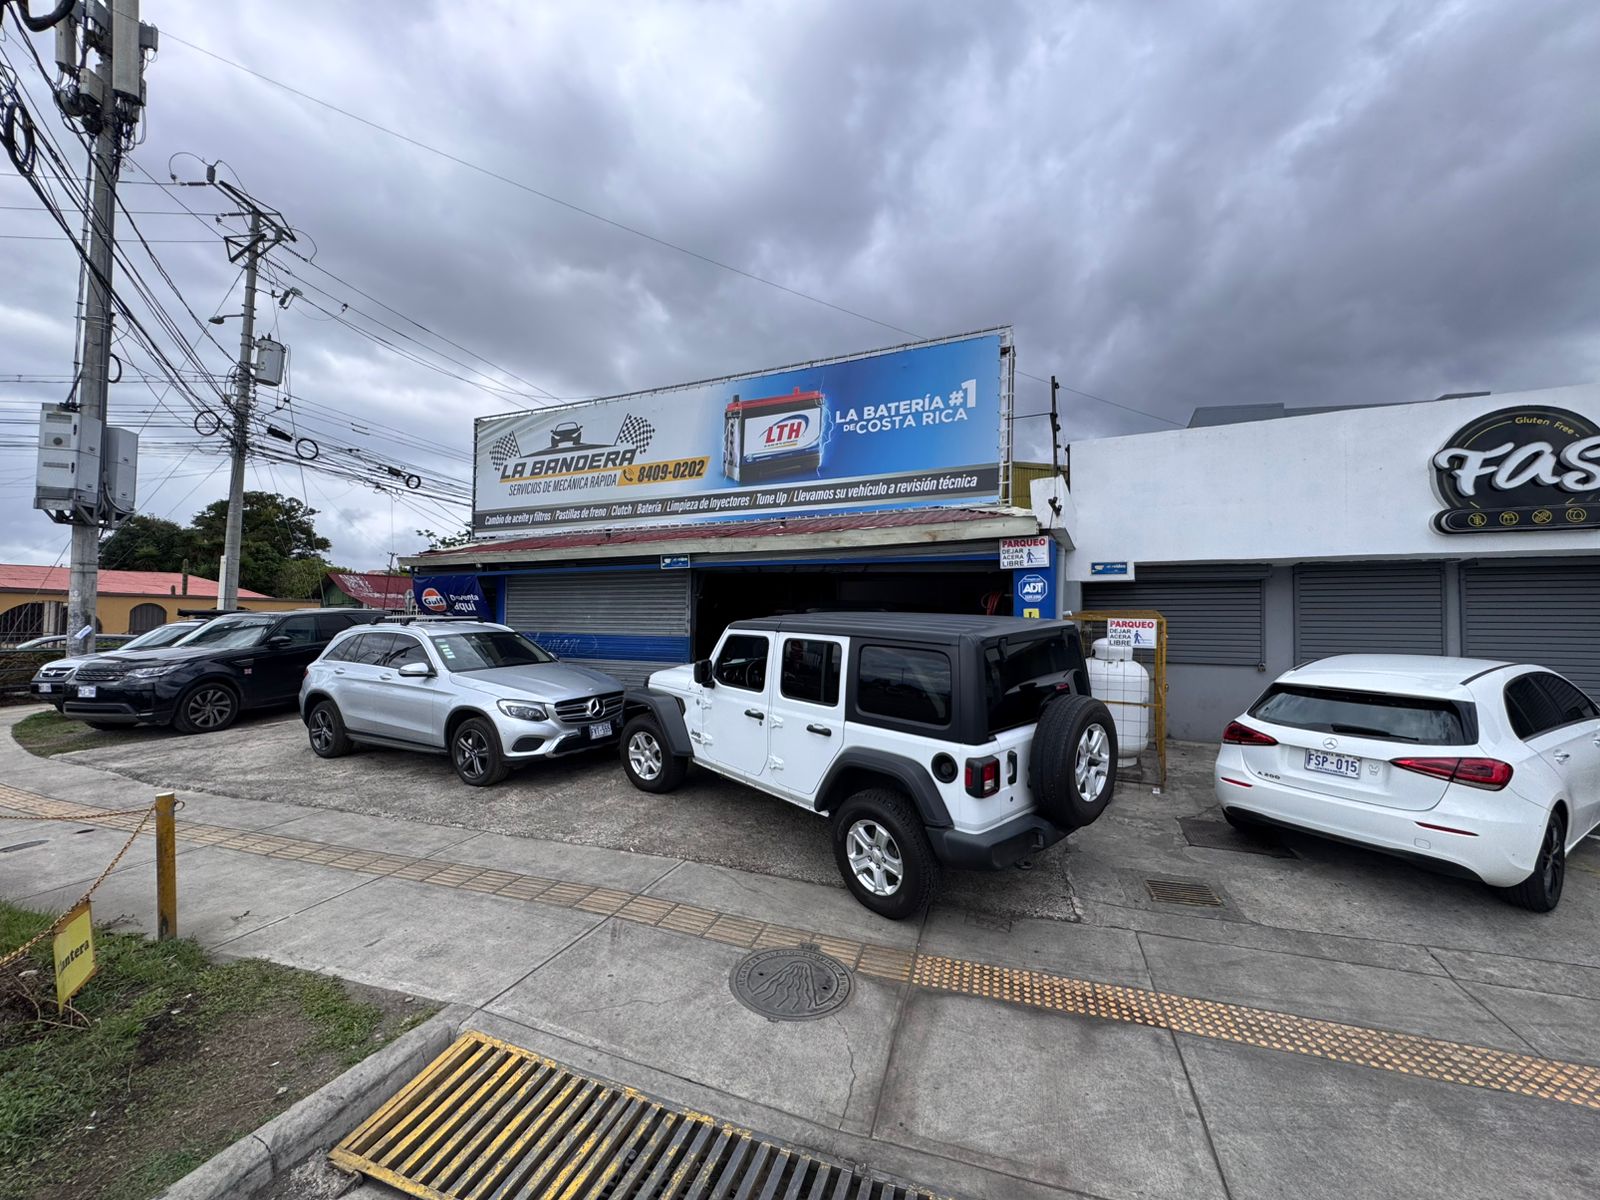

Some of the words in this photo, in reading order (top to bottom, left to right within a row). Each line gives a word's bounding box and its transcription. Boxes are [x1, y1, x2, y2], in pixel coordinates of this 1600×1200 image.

[835, 408, 858, 423] LA
[863, 393, 945, 420] BATERÍA
[948, 378, 977, 409] #1
[843, 423, 855, 432] DE
[855, 415, 916, 434] COSTA
[922, 407, 968, 426] RICA
[1515, 416, 1550, 426] Gluten
[1553, 421, 1575, 435] Free
[764, 421, 802, 444] LTH
[500, 462, 527, 480] LA
[530, 449, 638, 477] BANDERA
[637, 459, 705, 482] 8409-0202
[508, 481, 542, 497] SERVICIOS
[542, 481, 552, 493] DE
[552, 475, 589, 492] MECÁNICA
[589, 472, 617, 489] RÁPIDA
[485, 514, 504, 525] Cambio
[505, 513, 511, 524] de
[512, 512, 529, 524] aceite
[528, 515, 534, 525] y
[534, 511, 551, 522] filtros
[555, 508, 580, 520] Pastillas
[581, 507, 589, 518] de
[589, 506, 607, 518] freno
[611, 504, 632, 516] Clutch
[637, 502, 661, 514] Batería
[666, 499, 698, 513] Limpieza
[699, 498, 709, 509] de
[709, 495, 750, 511] Inyectores
[756, 493, 774, 505] Tune
[776, 492, 787, 506] Up
[793, 489, 834, 502] Llevamos
[835, 488, 846, 499] su
[848, 481, 888, 498] vehículo
[888, 484, 894, 494] a
[896, 477, 937, 493] revisión
[938, 474, 978, 490] técnica
[1002, 538, 1046, 548] PARQUEO
[1022, 582, 1043, 593] ADT
[424, 597, 444, 606] Gulf
[1110, 620, 1155, 629] PARQUEO
[1307, 753, 1358, 773] FSP-015
